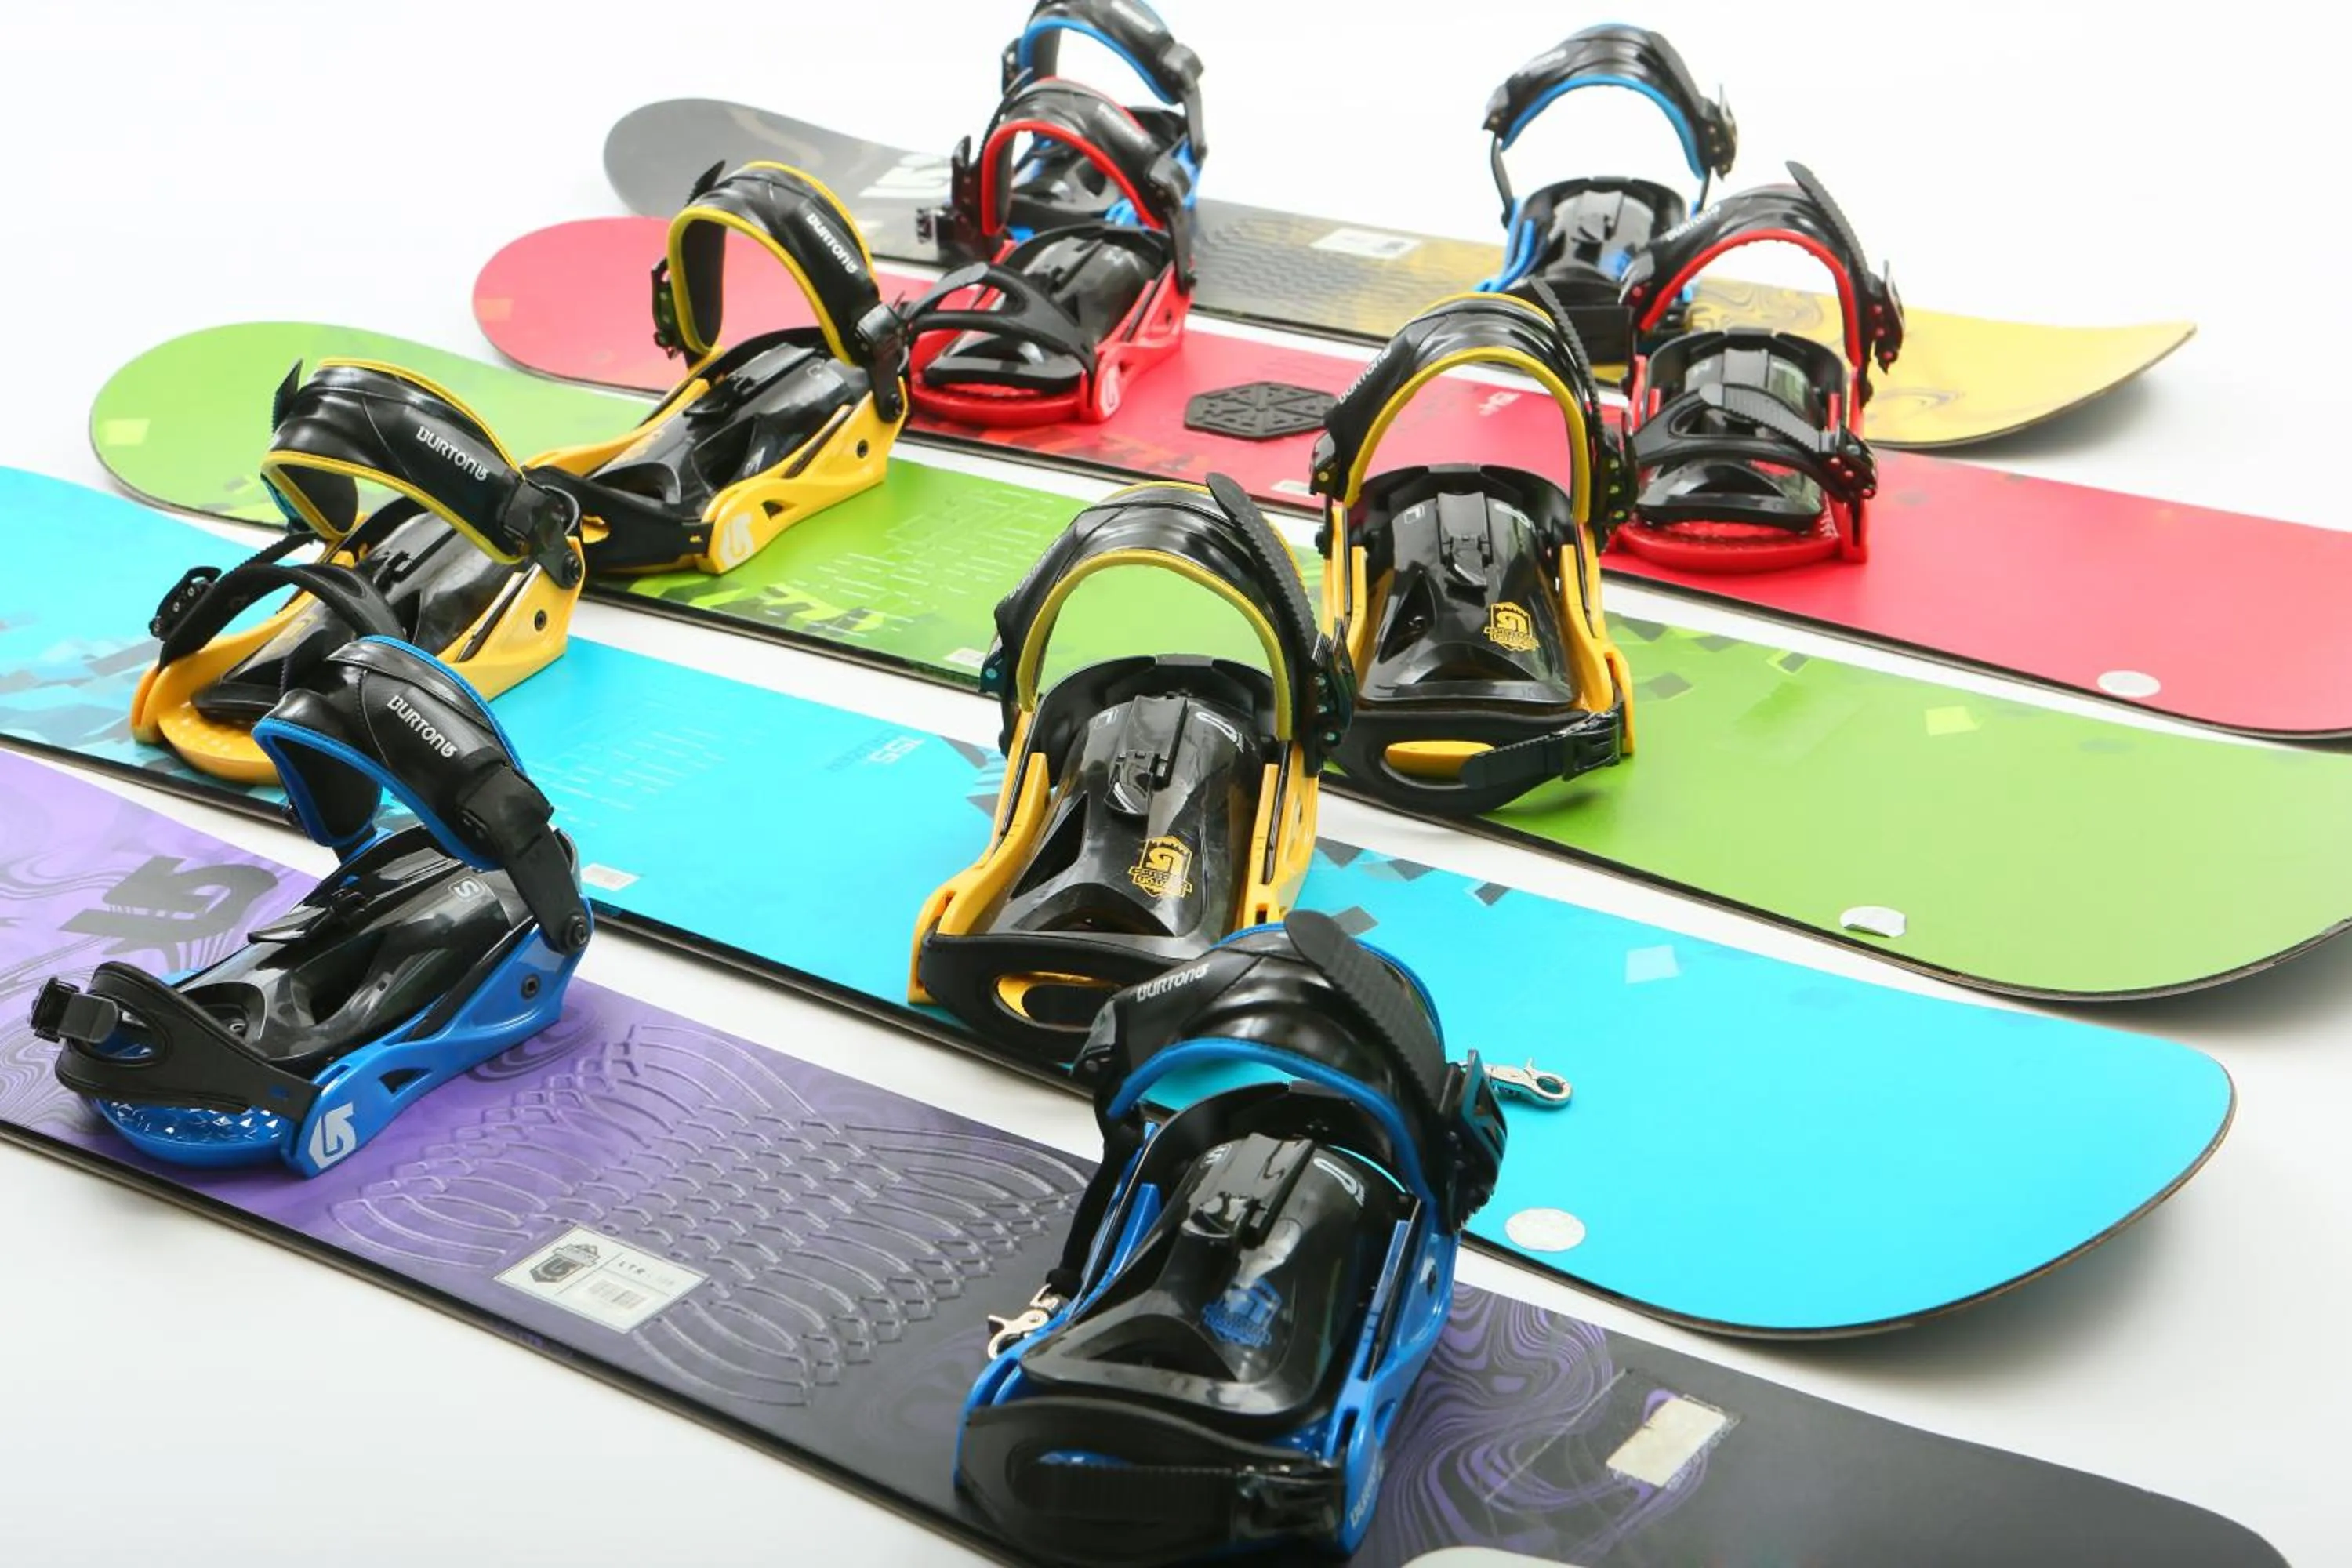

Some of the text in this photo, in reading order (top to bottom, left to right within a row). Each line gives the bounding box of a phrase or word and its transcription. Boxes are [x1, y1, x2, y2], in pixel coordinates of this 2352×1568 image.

[415, 425, 477, 475] BURTON
[387, 695, 447, 751] BURTON
[453, 880, 480, 898] S
[1136, 968, 1196, 1003] BURTON
